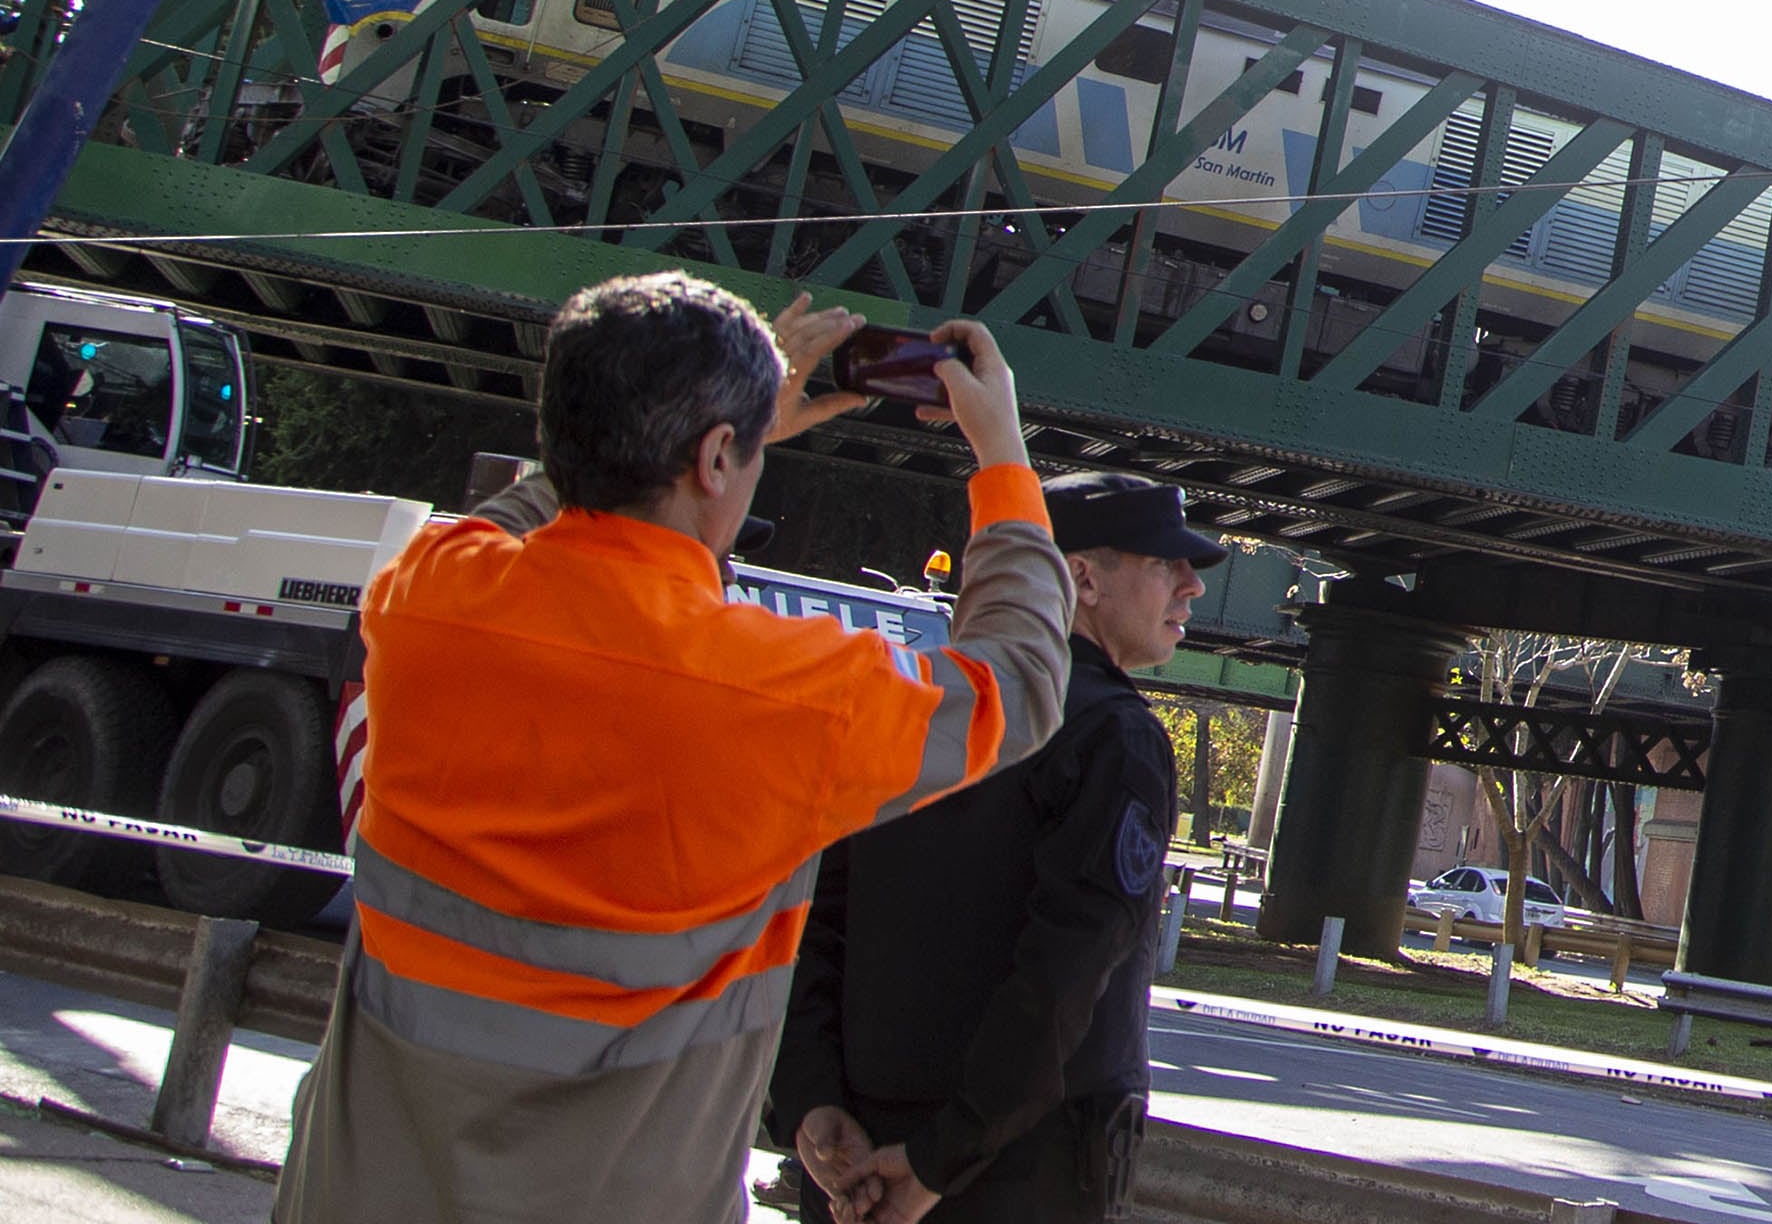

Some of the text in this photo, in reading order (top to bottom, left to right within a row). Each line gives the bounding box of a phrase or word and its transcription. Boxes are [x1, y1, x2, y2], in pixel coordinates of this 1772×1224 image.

[1194, 156, 1276, 187] San Martín
[278, 577, 362, 607] LIEBHERR
